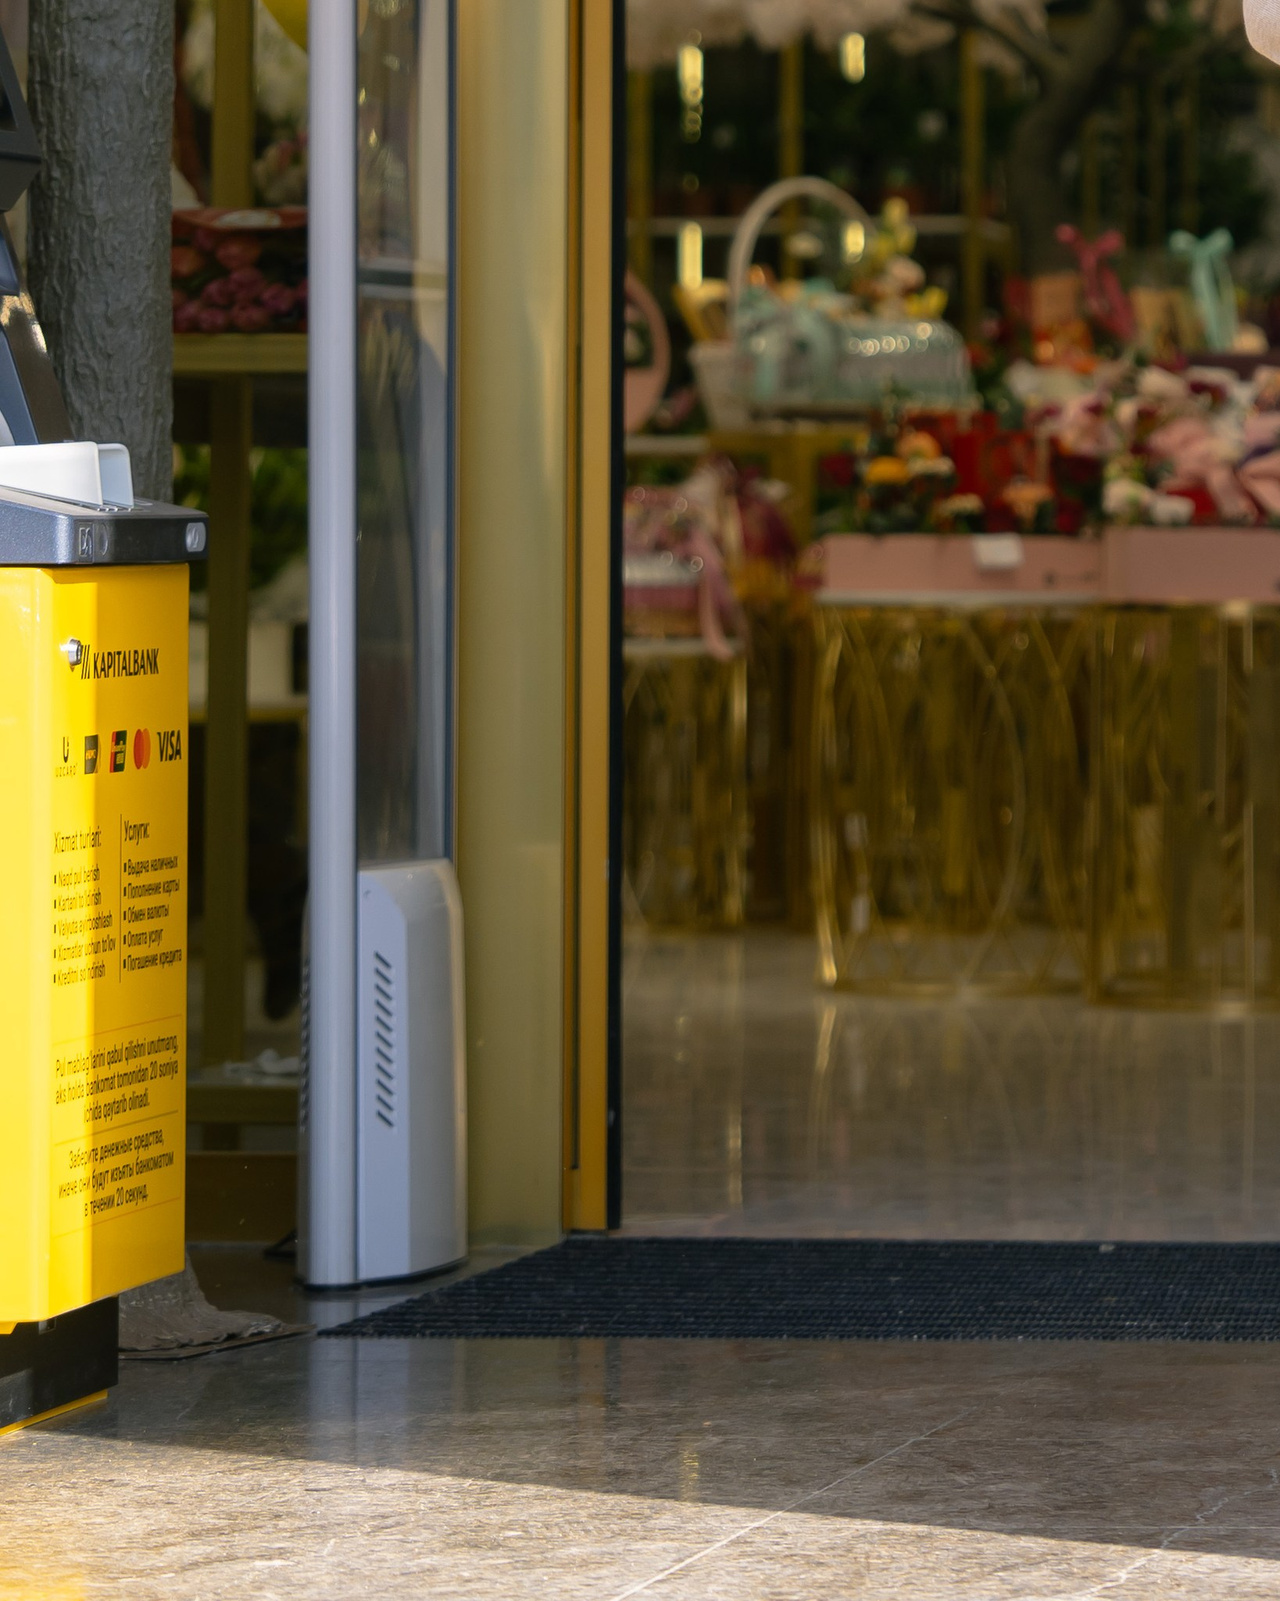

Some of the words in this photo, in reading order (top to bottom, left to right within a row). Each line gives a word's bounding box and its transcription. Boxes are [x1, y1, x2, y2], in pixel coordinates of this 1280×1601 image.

[93, 648, 160, 679] KAPITALBANK
[157, 730, 182, 762] VISA
[54, 831, 78, 854] Xizmat
[124, 820, 150, 846] Услуги:
[128, 858, 150, 877] Выдача
[150, 856, 179, 872] наличных
[128, 882, 162, 899] Пополнение
[163, 879, 181, 897] карты
[127, 905, 146, 923] Обмен
[147, 904, 170, 920] валюты
[127, 931, 147, 948] Оплата
[148, 928, 164, 948] услуг
[127, 953, 158, 971] Погашение
[159, 948, 183, 969] кредита
[106, 1042, 124, 1070] qabul
[86, 1072, 116, 1097] bankomat
[116, 1063, 149, 1089] tomonidan
[149, 1060, 158, 1080] 20
[158, 1056, 179, 1080] soniya
[68, 1147, 99, 1170] Заберите
[99, 1137, 133, 1164] денежные
[133, 1128, 165, 1154] средства,
[91, 1168, 110, 1192] будут
[110, 1162, 135, 1183] изъяты
[135, 1151, 175, 1176] банкоматом
[90, 1195, 116, 1216] течении
[116, 1186, 124, 1207] 20
